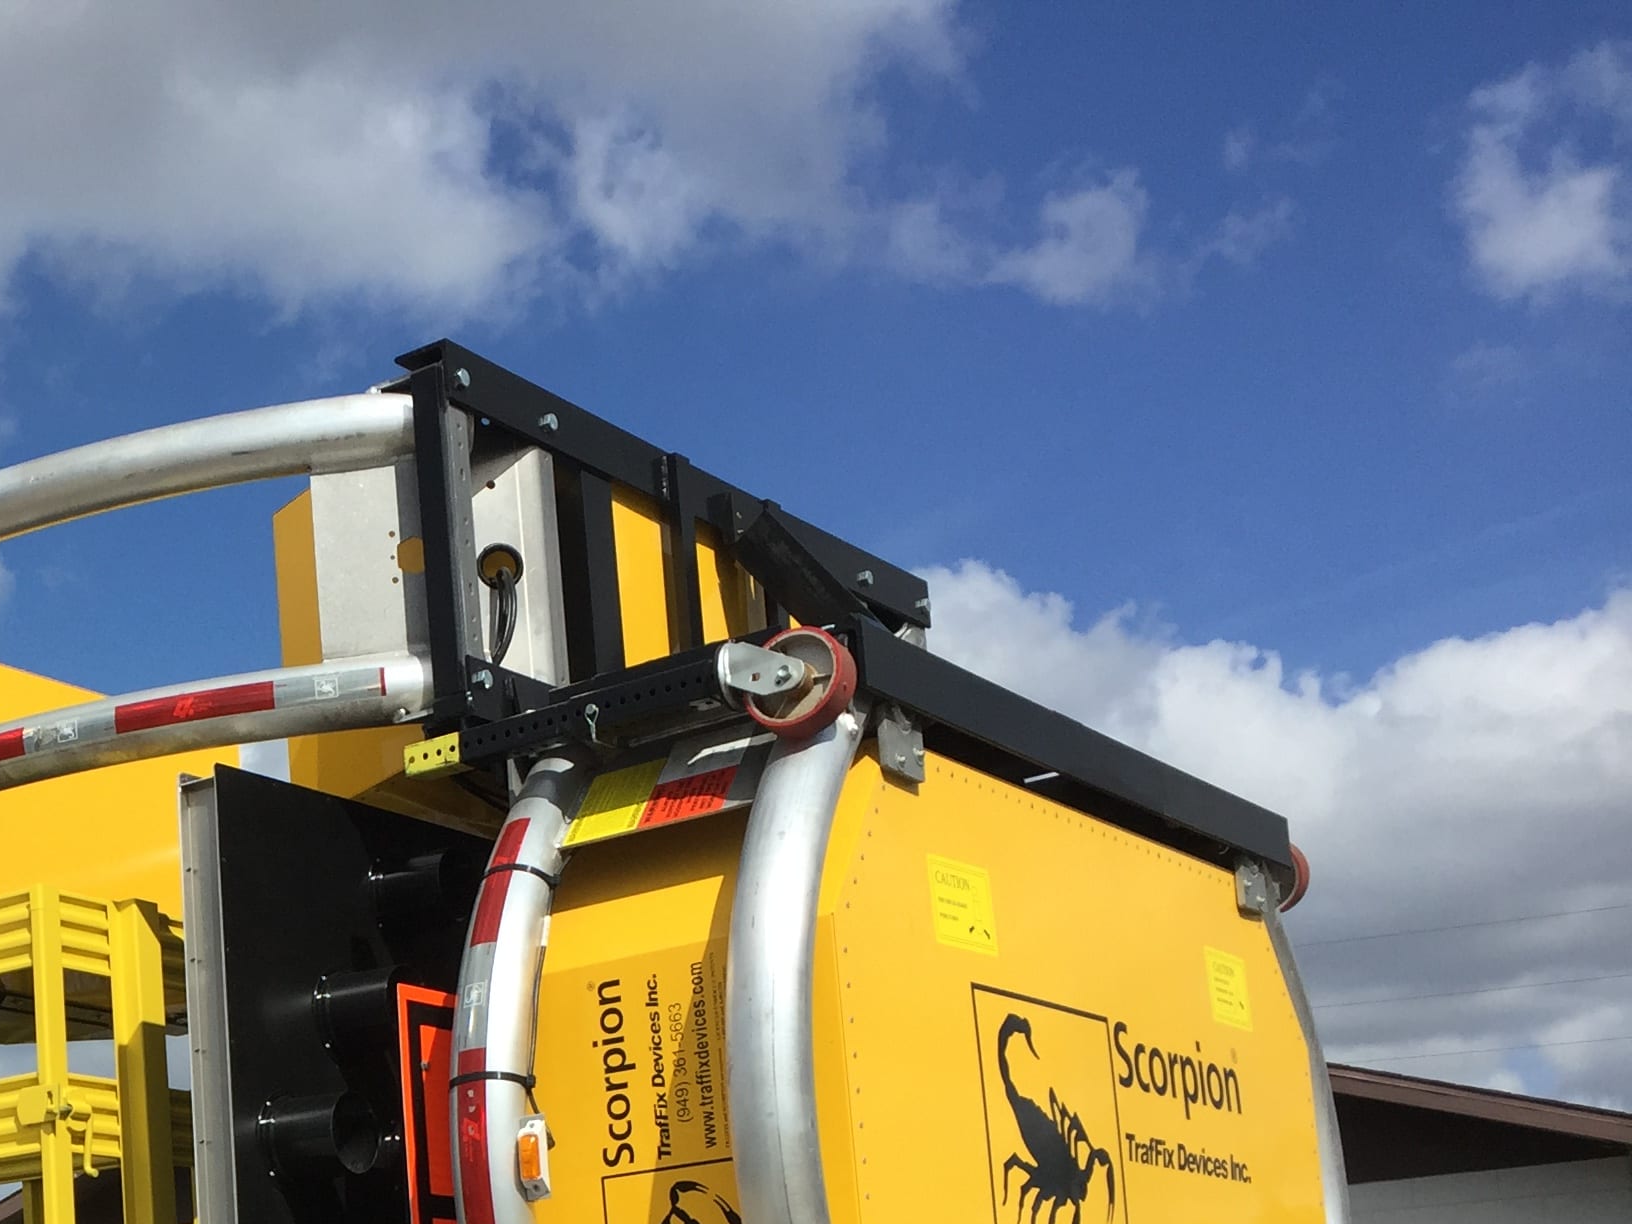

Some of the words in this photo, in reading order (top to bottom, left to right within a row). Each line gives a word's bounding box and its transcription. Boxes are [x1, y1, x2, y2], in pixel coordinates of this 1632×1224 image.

[935, 870, 970, 890] CAUTION
[645, 974, 659, 1007] Inc.
[592, 978, 636, 1167] Scorpion
[649, 1010, 666, 1088] Devices
[668, 1002, 687, 1078] 361-5663
[690, 961, 717, 1149] www.traffixdevices.com
[1113, 1021, 1242, 1120] Scorpion
[653, 1092, 672, 1160] TrafFix
[676, 1081, 694, 1123] (949)
[1125, 1132, 1175, 1169] TrafFix
[1177, 1143, 1228, 1179] Devices
[1230, 1154, 1252, 1184] Inc.
